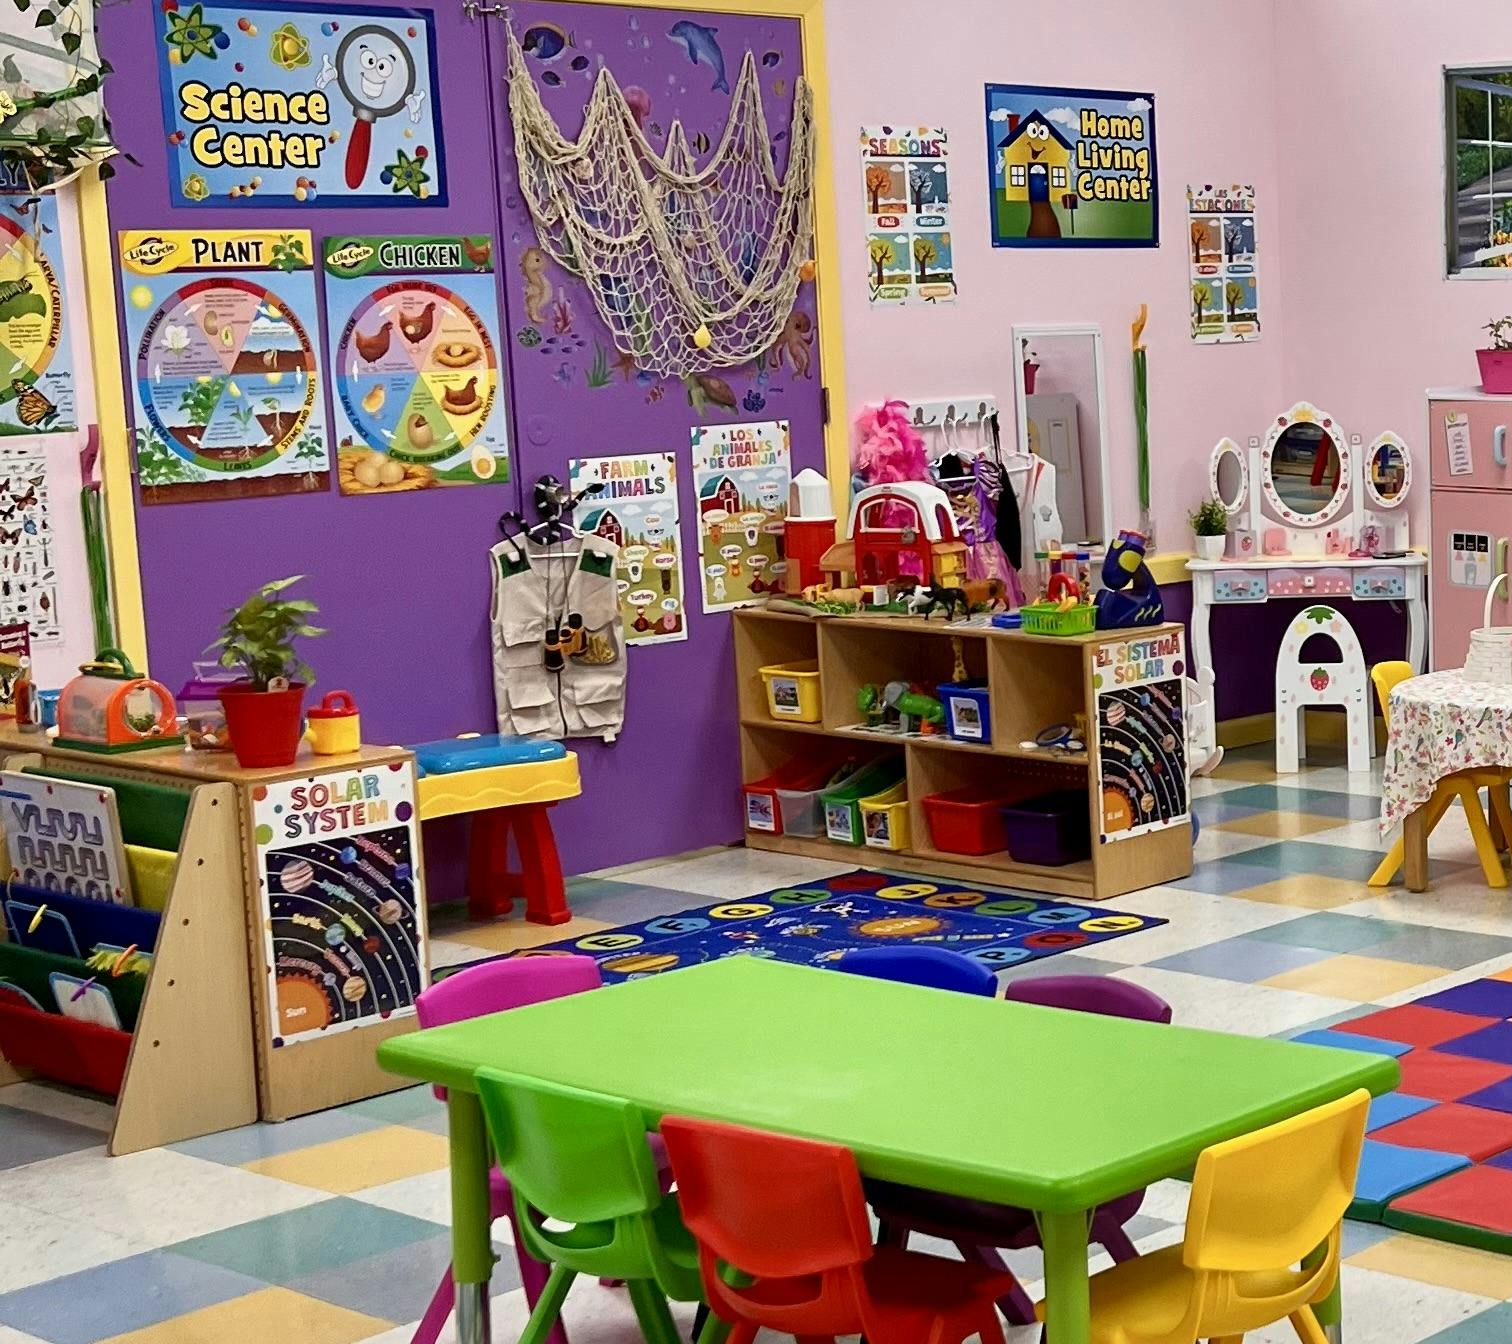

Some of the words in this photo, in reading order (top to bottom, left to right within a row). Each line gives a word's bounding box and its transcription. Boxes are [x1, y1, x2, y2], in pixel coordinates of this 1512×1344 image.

[180, 81, 329, 124] Science
[1080, 108, 1143, 140] Home
[191, 124, 325, 167] Center
[869, 138, 941, 155] SEASONS
[1076, 141, 1150, 178] Living
[1077, 171, 1151, 202] Center
[881, 217, 896, 226] Fall
[919, 217, 943, 226] Winter
[129, 249, 148, 261] Life
[149, 243, 175, 256] Cycle
[192, 239, 263, 264] PLANT
[349, 248, 372, 260] Cycle
[381, 242, 460, 267] CHICKEN
[304, 378, 316, 406] ROOTS
[300, 409, 310, 427] AND
[281, 430, 300, 450] STEMS
[730, 430, 754, 442] LOS
[713, 440, 773, 456] ANIMALES
[600, 459, 649, 480] FARM
[709, 457, 725, 470] DE
[728, 450, 777, 468] GRANJA
[630, 593, 654, 602] Turkey
[1096, 649, 1113, 667] EL
[1117, 635, 1180, 663] SISTEMA
[1114, 659, 1164, 684] SOLAR
[291, 775, 380, 811] SOLAR
[285, 800, 388, 838] SYSTEM
[722, 907, 751, 917] G
[1095, 920, 1127, 929] N
[589, 937, 621, 948] E
[286, 1006, 307, 1018] Sun
